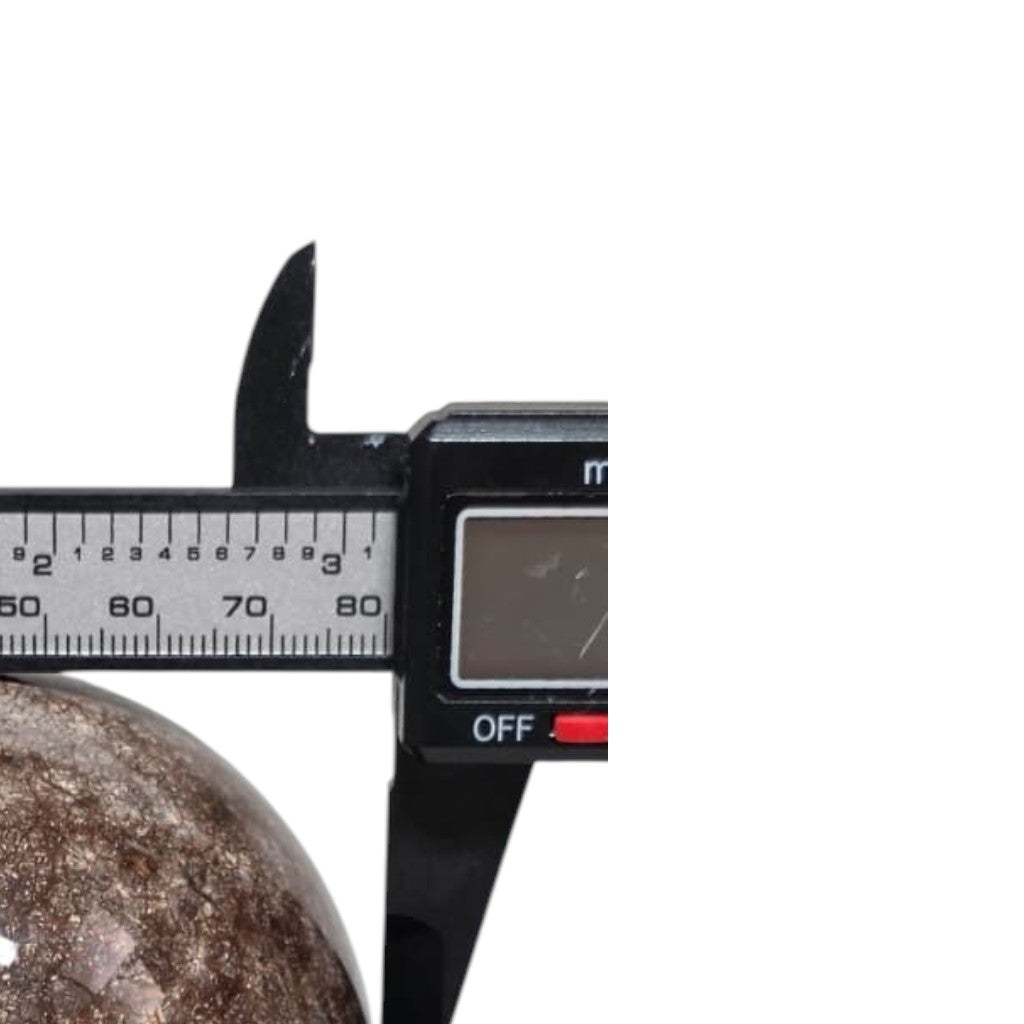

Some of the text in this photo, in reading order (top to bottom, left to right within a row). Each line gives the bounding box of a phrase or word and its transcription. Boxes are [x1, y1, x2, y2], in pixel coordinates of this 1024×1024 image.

[32, 555, 53, 577] 2
[73, 546, 82, 562] 1
[101, 546, 115, 562] 2
[129, 546, 143, 562] 3
[157, 546, 171, 561] 4
[243, 545, 257, 561] 7
[321, 554, 342, 576] 3
[363, 545, 372, 560] 1
[108, 594, 155, 619] 60
[222, 594, 268, 618] 70
[335, 594, 383, 618] 80
[472, 713, 536, 743] OFF
